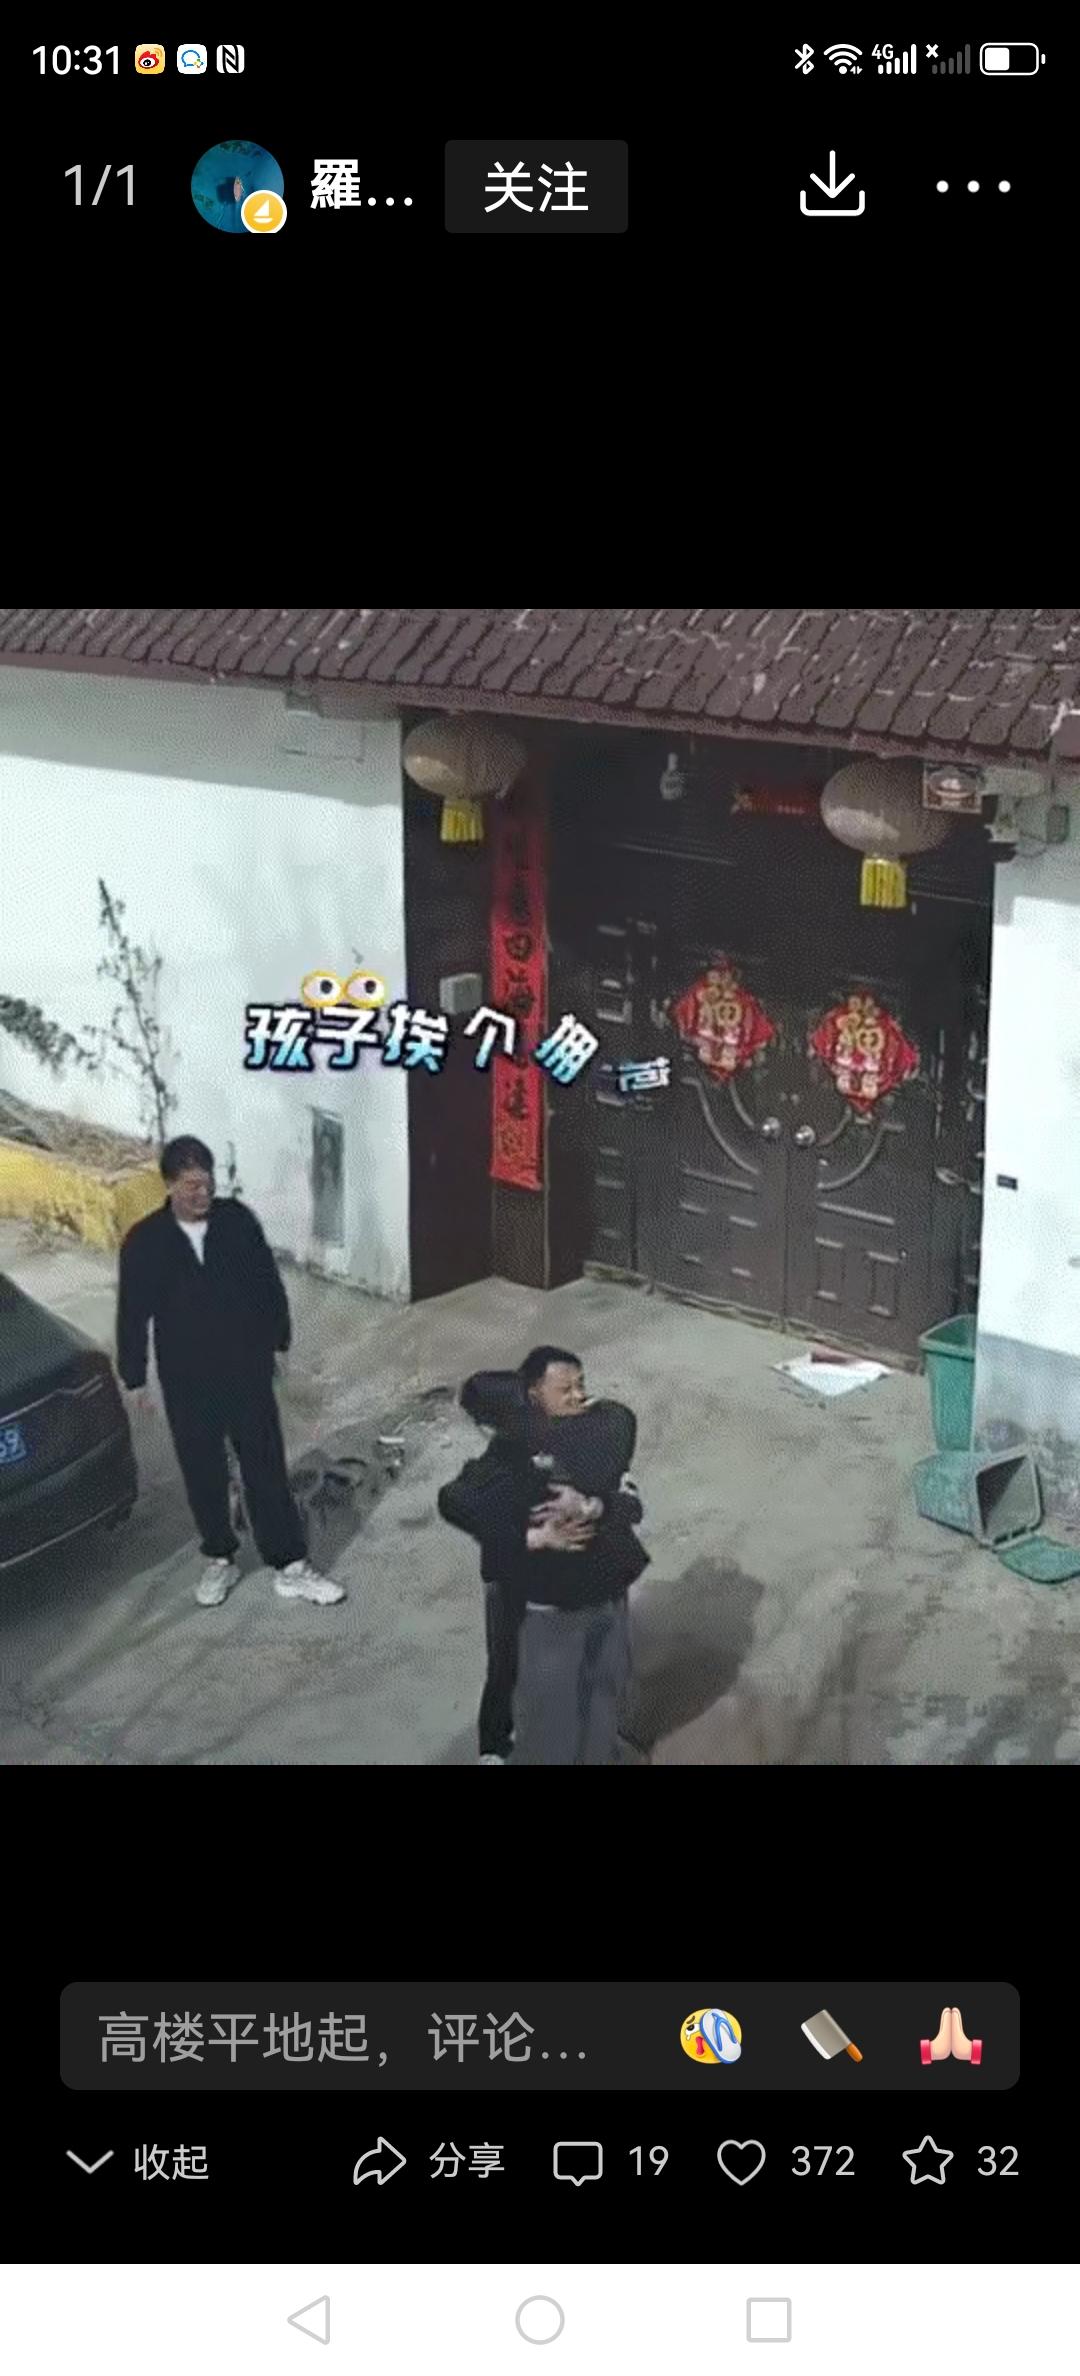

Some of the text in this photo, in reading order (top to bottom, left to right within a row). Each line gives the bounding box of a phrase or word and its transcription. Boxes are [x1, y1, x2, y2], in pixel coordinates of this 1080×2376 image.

[33, 44, 119, 75] 10:31
[872, 43, 894, 62] 4G
[65, 165, 134, 206] 1/1
[485, 160, 588, 213] 关注
[134, 2143, 209, 2181] 收起
[429, 2141, 505, 2179] 分享
[629, 2145, 669, 2176] 19
[791, 2145, 855, 2177] 372
[977, 2145, 1019, 2177] 32
